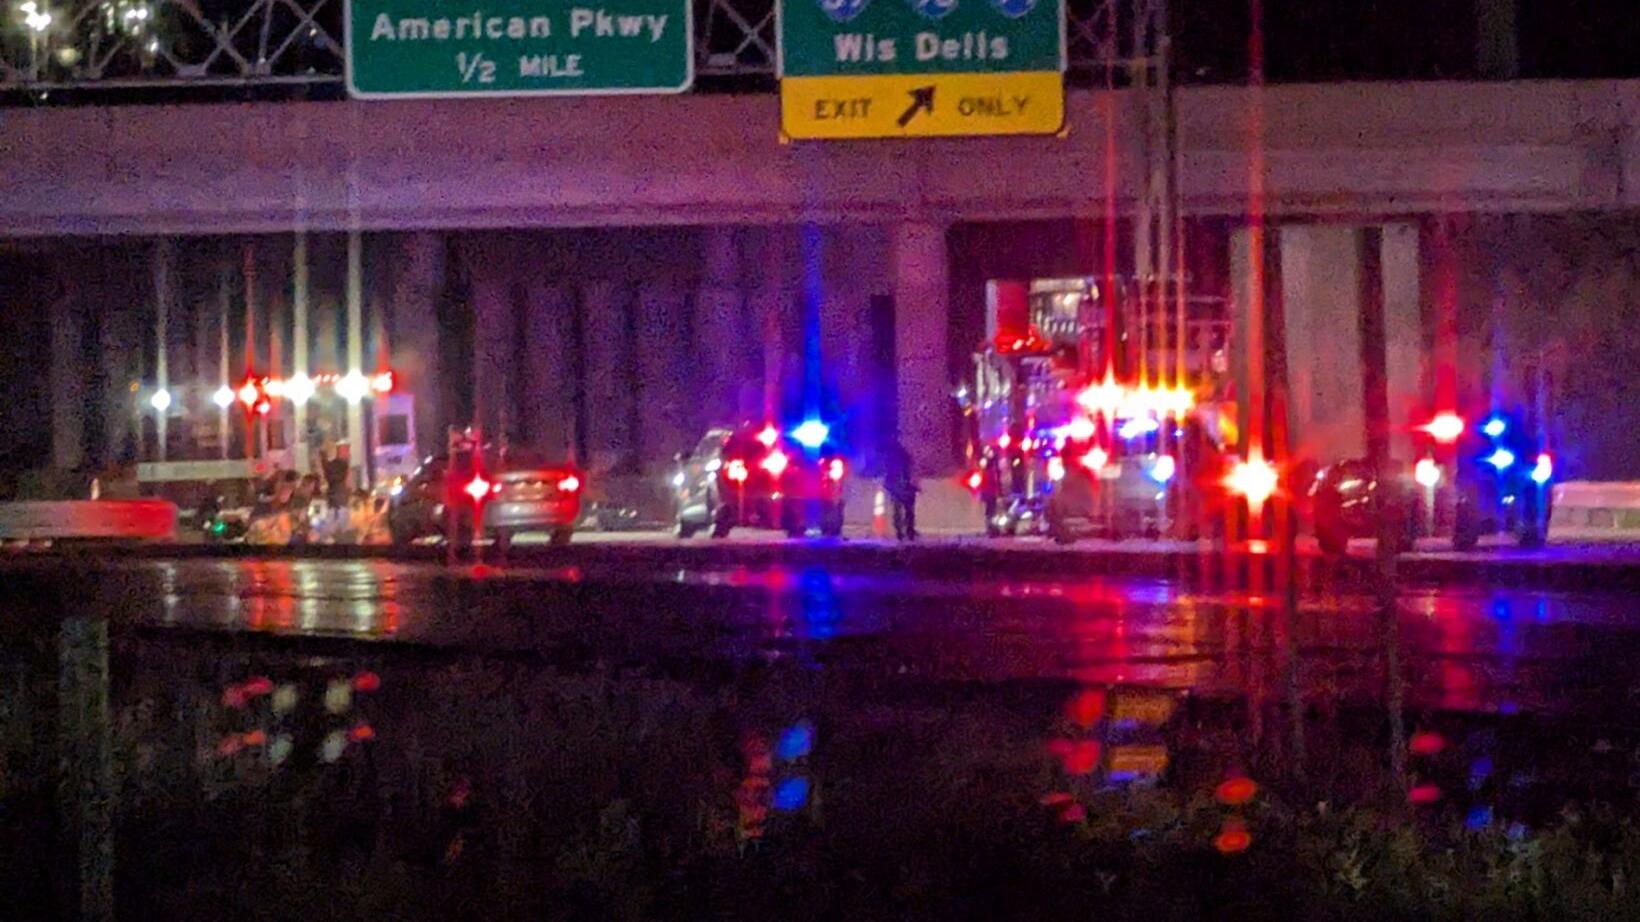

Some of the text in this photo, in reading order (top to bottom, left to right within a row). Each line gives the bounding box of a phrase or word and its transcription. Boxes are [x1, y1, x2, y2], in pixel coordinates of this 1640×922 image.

[370, 8, 668, 43] American Pkwy
[833, 31, 1008, 62] Wis Dells
[519, 54, 583, 77] MILE
[814, 95, 1030, 120] EXIT ONLY
